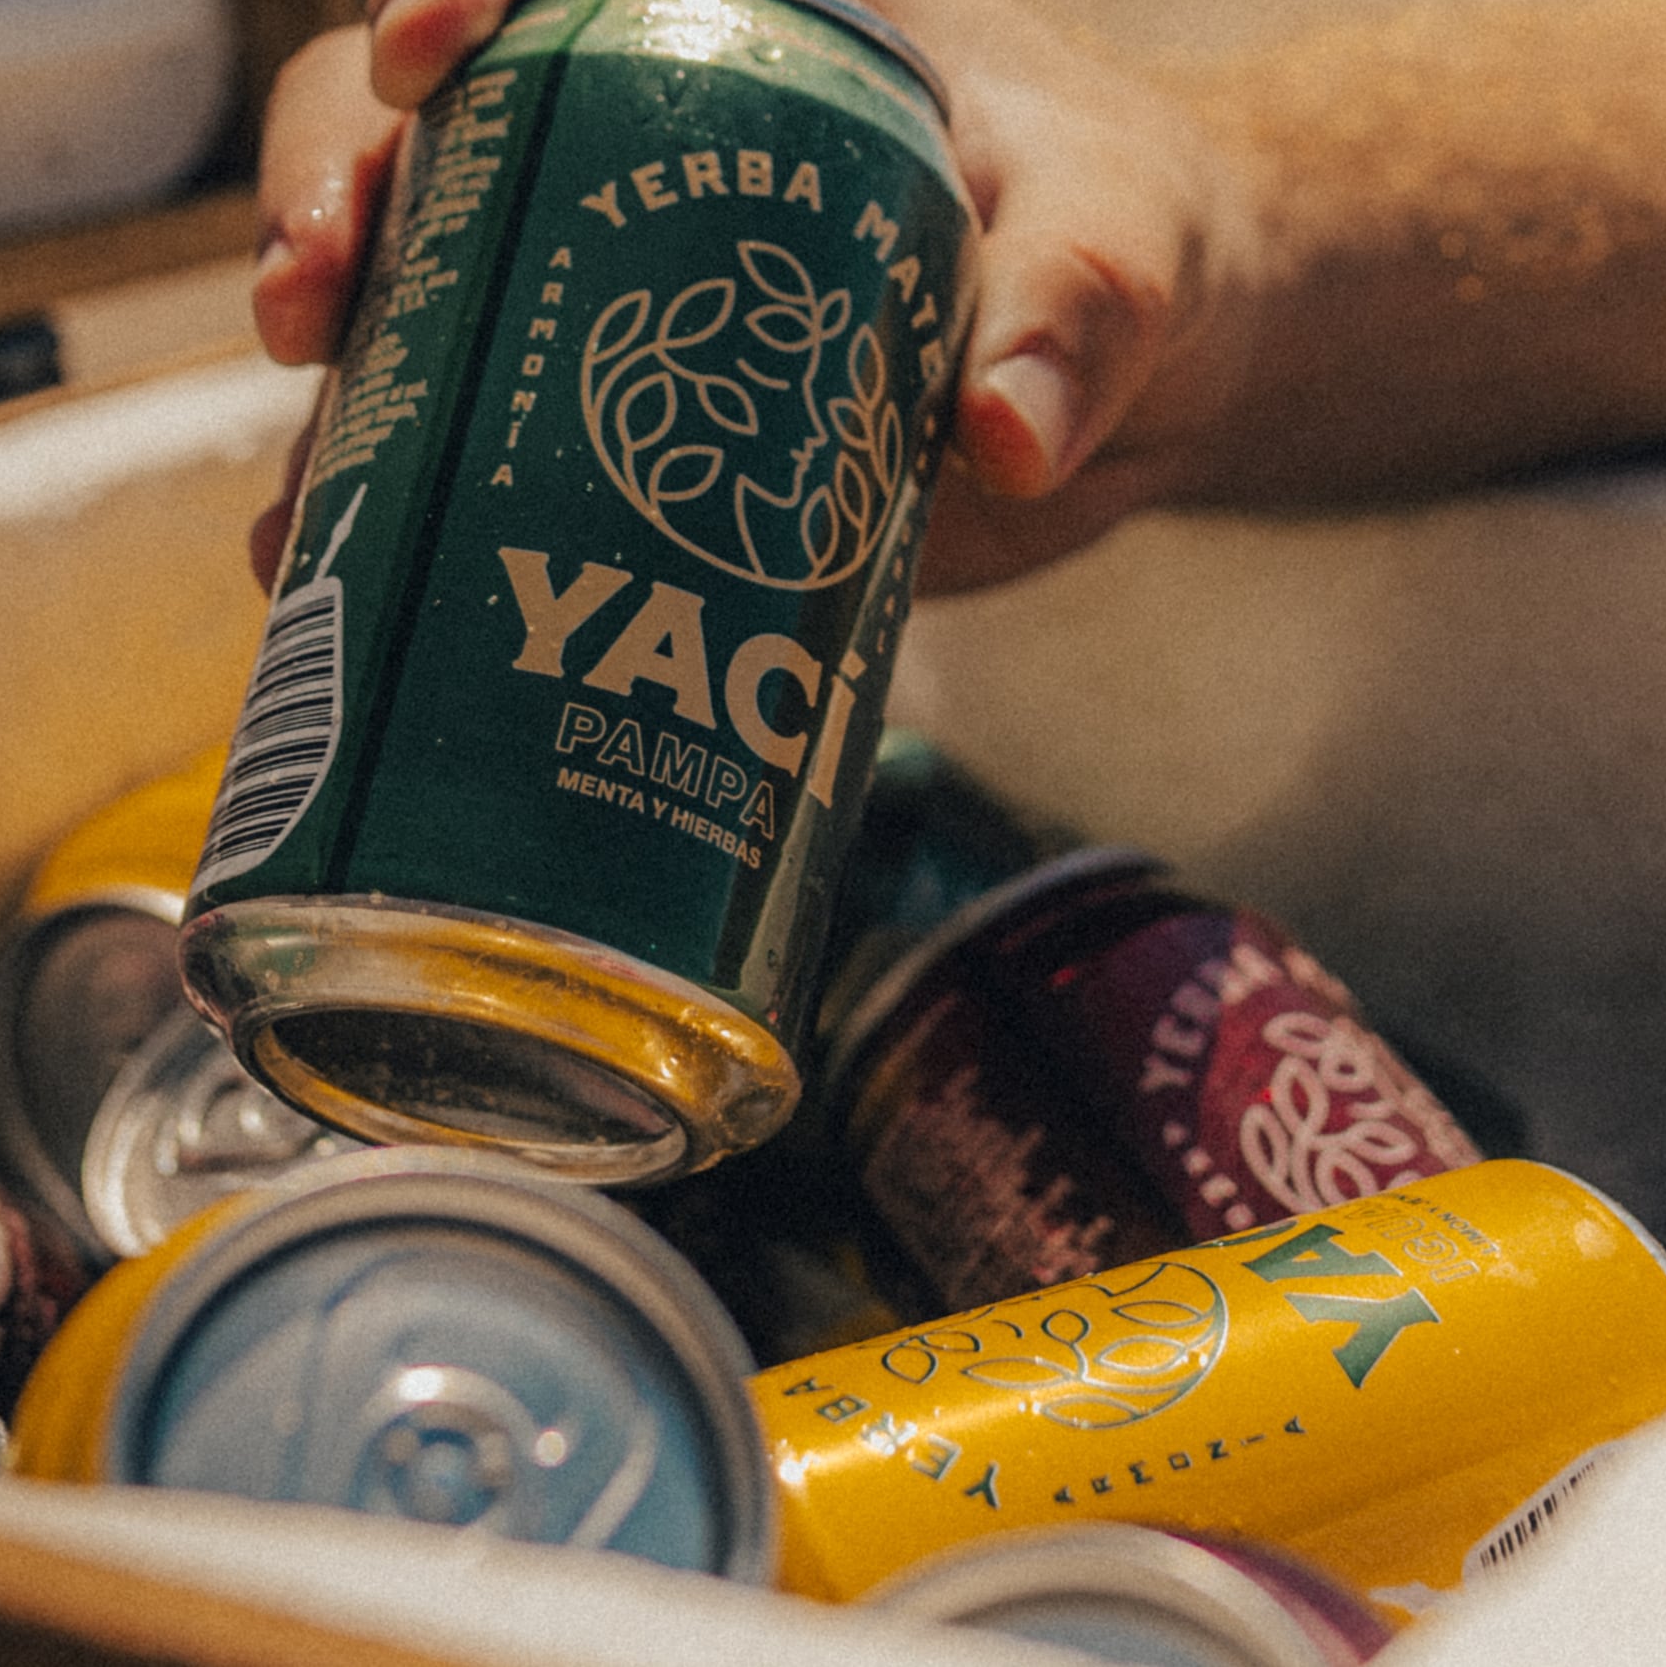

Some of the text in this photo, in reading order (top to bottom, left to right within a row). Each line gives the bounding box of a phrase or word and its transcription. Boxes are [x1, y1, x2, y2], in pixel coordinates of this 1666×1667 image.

[580, 149, 823, 229] YERBA
[555, 701, 775, 841] PAMPA
[556, 767, 763, 870] MENTA Y HIERBAS
